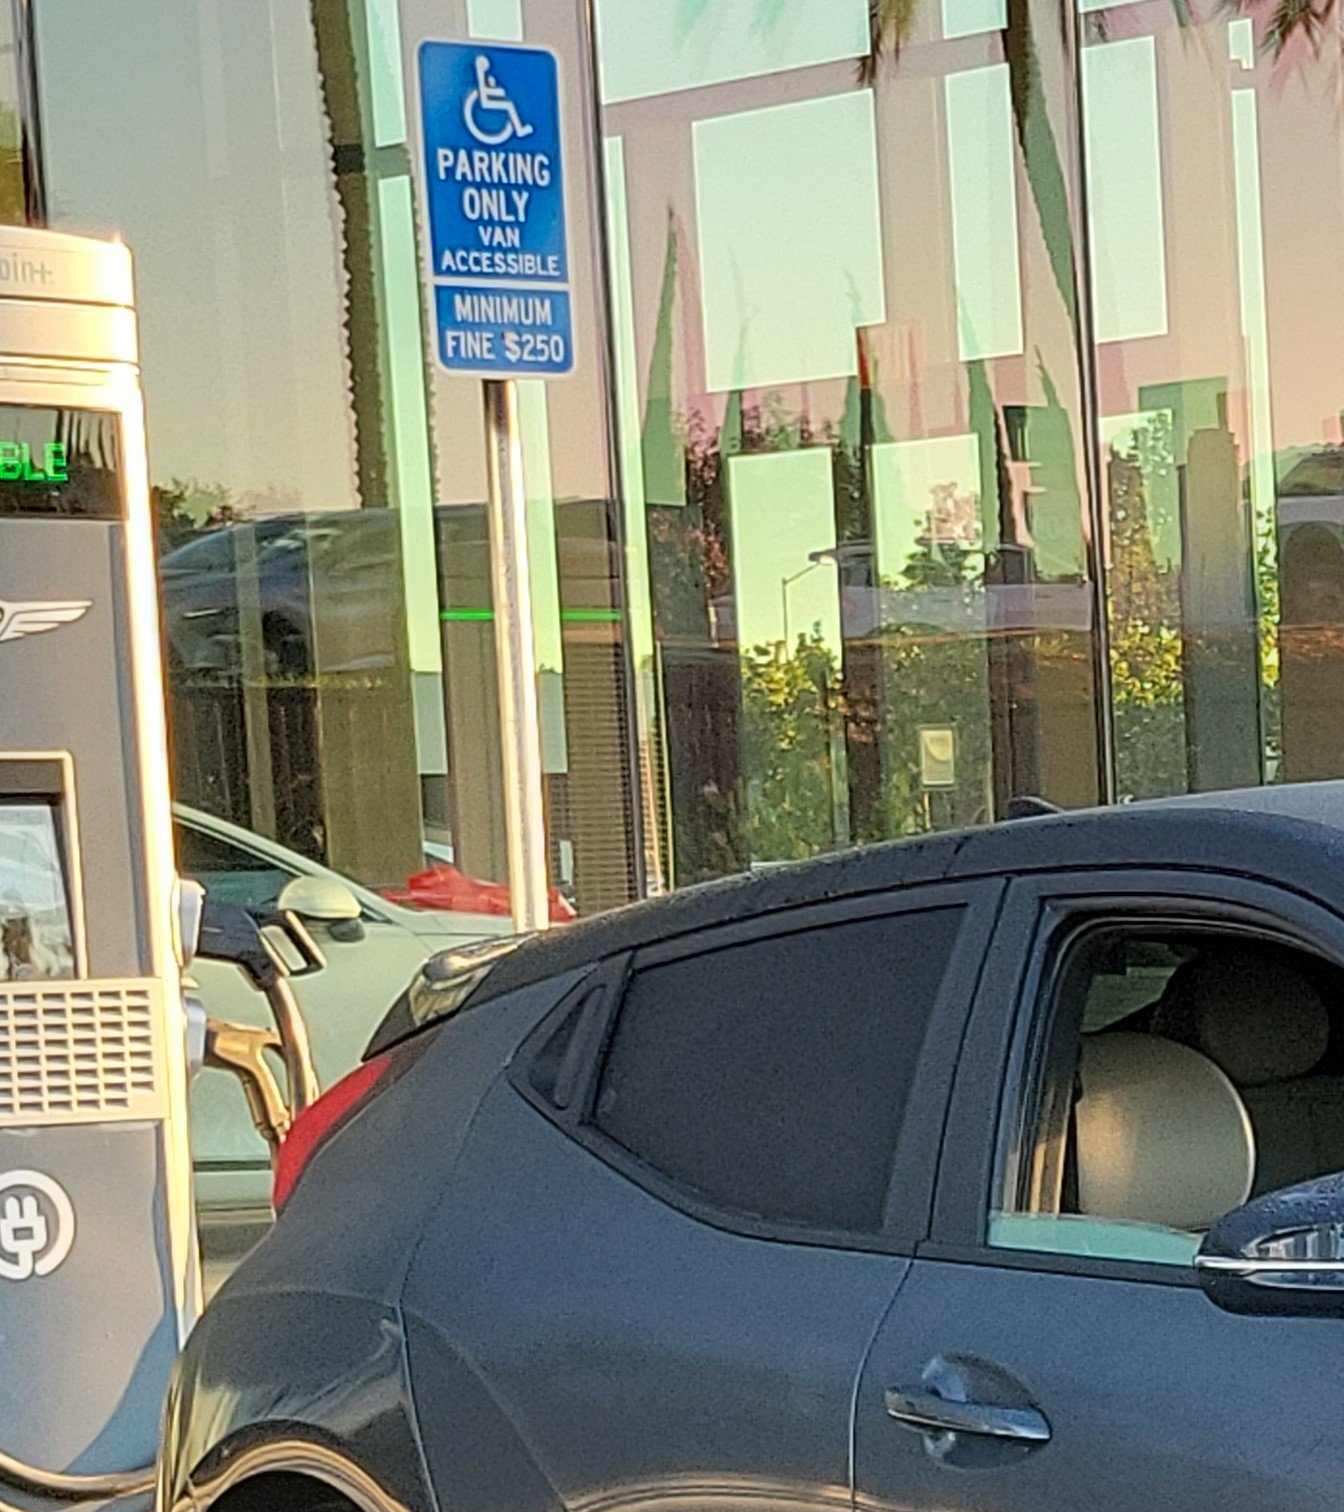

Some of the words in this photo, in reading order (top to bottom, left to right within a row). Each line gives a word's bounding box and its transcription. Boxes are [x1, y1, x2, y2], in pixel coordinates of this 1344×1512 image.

[437, 147, 551, 187] PARKING
[463, 187, 530, 222] ONLY
[478, 225, 520, 248] VAN
[441, 250, 561, 276] ACCESSIBLE
[454, 294, 552, 326] MINIMUM
[445, 331, 496, 359] FINE
[504, 330, 564, 363] $250
